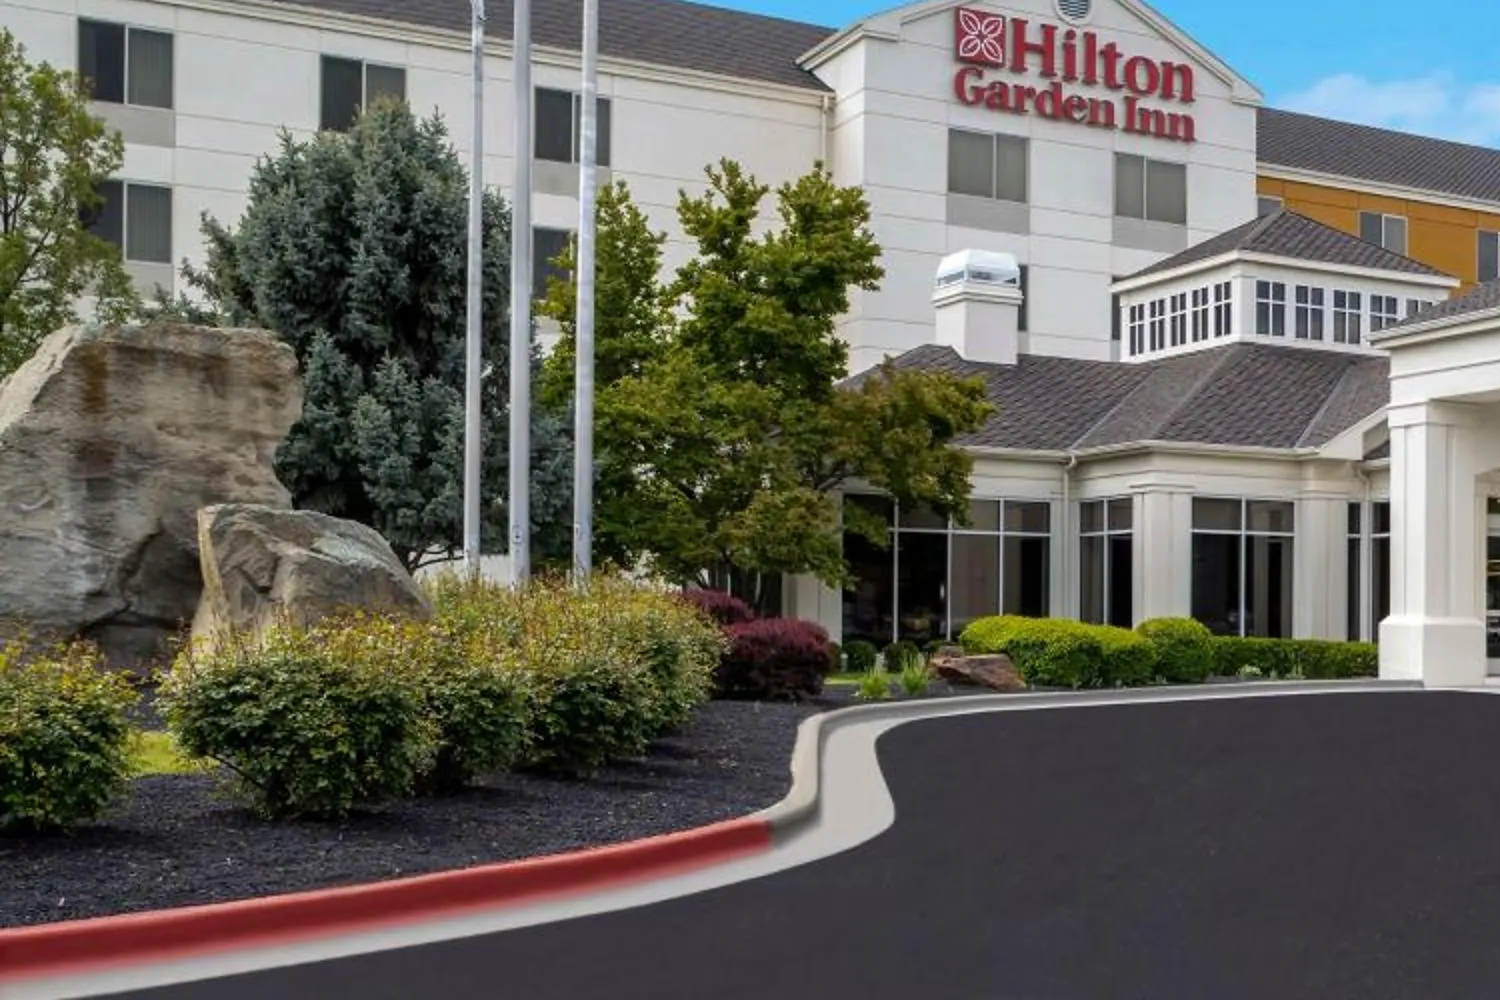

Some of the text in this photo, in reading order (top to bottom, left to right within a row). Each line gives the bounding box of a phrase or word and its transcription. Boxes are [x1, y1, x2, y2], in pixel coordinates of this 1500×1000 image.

[1010, 18, 1195, 103] Hilton
[954, 67, 1196, 142] Garden Inn
